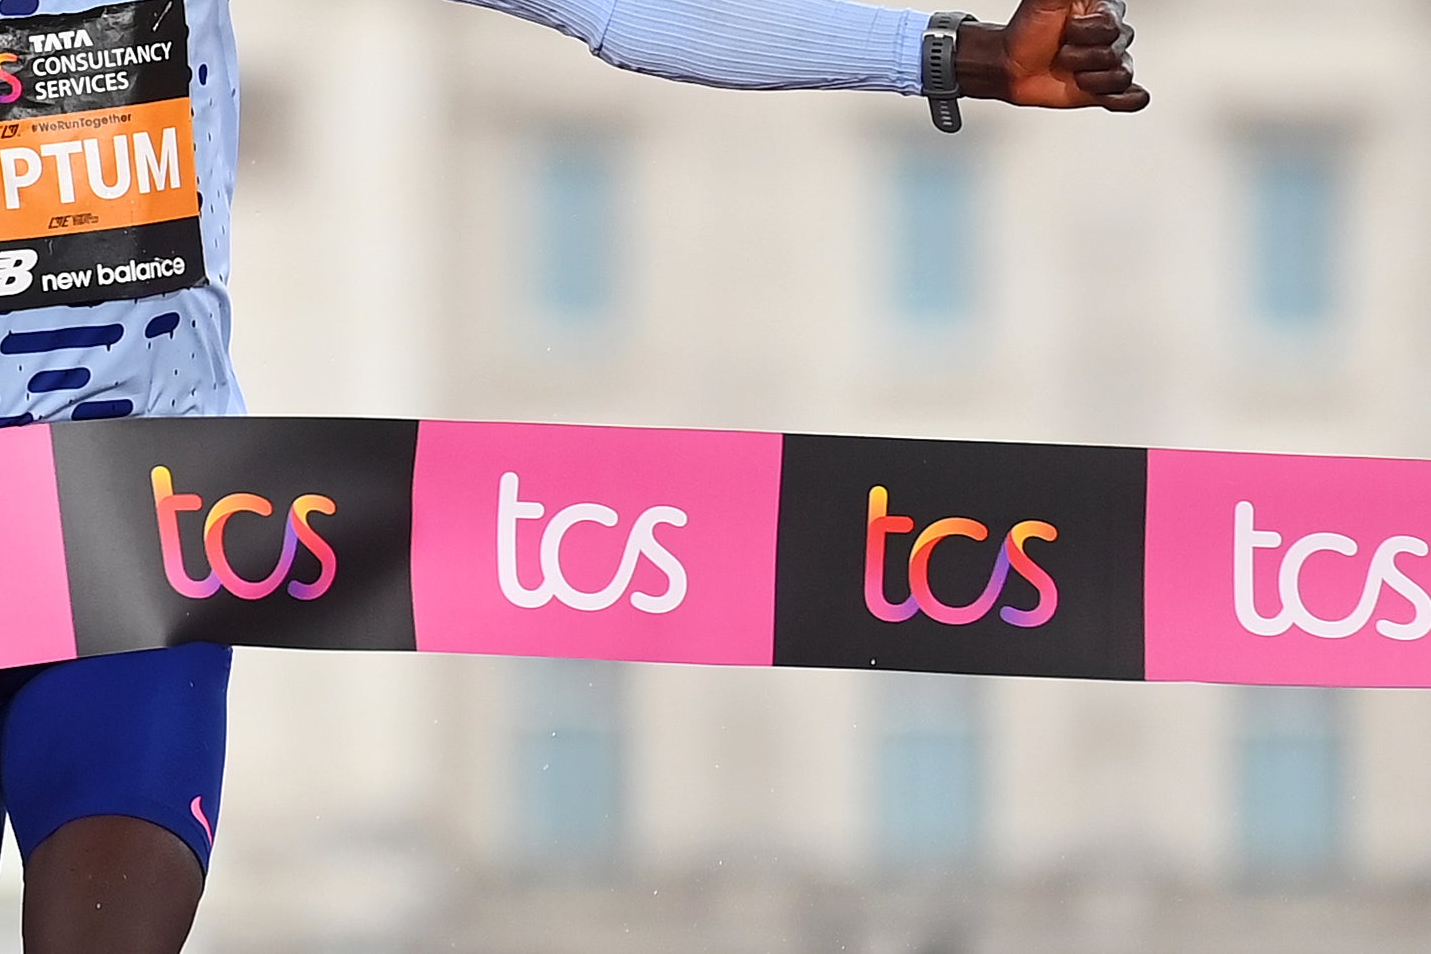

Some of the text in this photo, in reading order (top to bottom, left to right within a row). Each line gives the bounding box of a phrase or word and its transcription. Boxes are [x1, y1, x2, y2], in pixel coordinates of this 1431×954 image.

[29, 29, 93, 53] TATA
[32, 41, 172, 77] CONSULTANCY
[35, 71, 129, 100] SERVICES
[41, 256, 185, 292] new balance
[150, 465, 337, 600] tcs
[497, 472, 688, 613] tcs
[864, 485, 1058, 627] tcs
[1234, 501, 1431, 640] tcs
